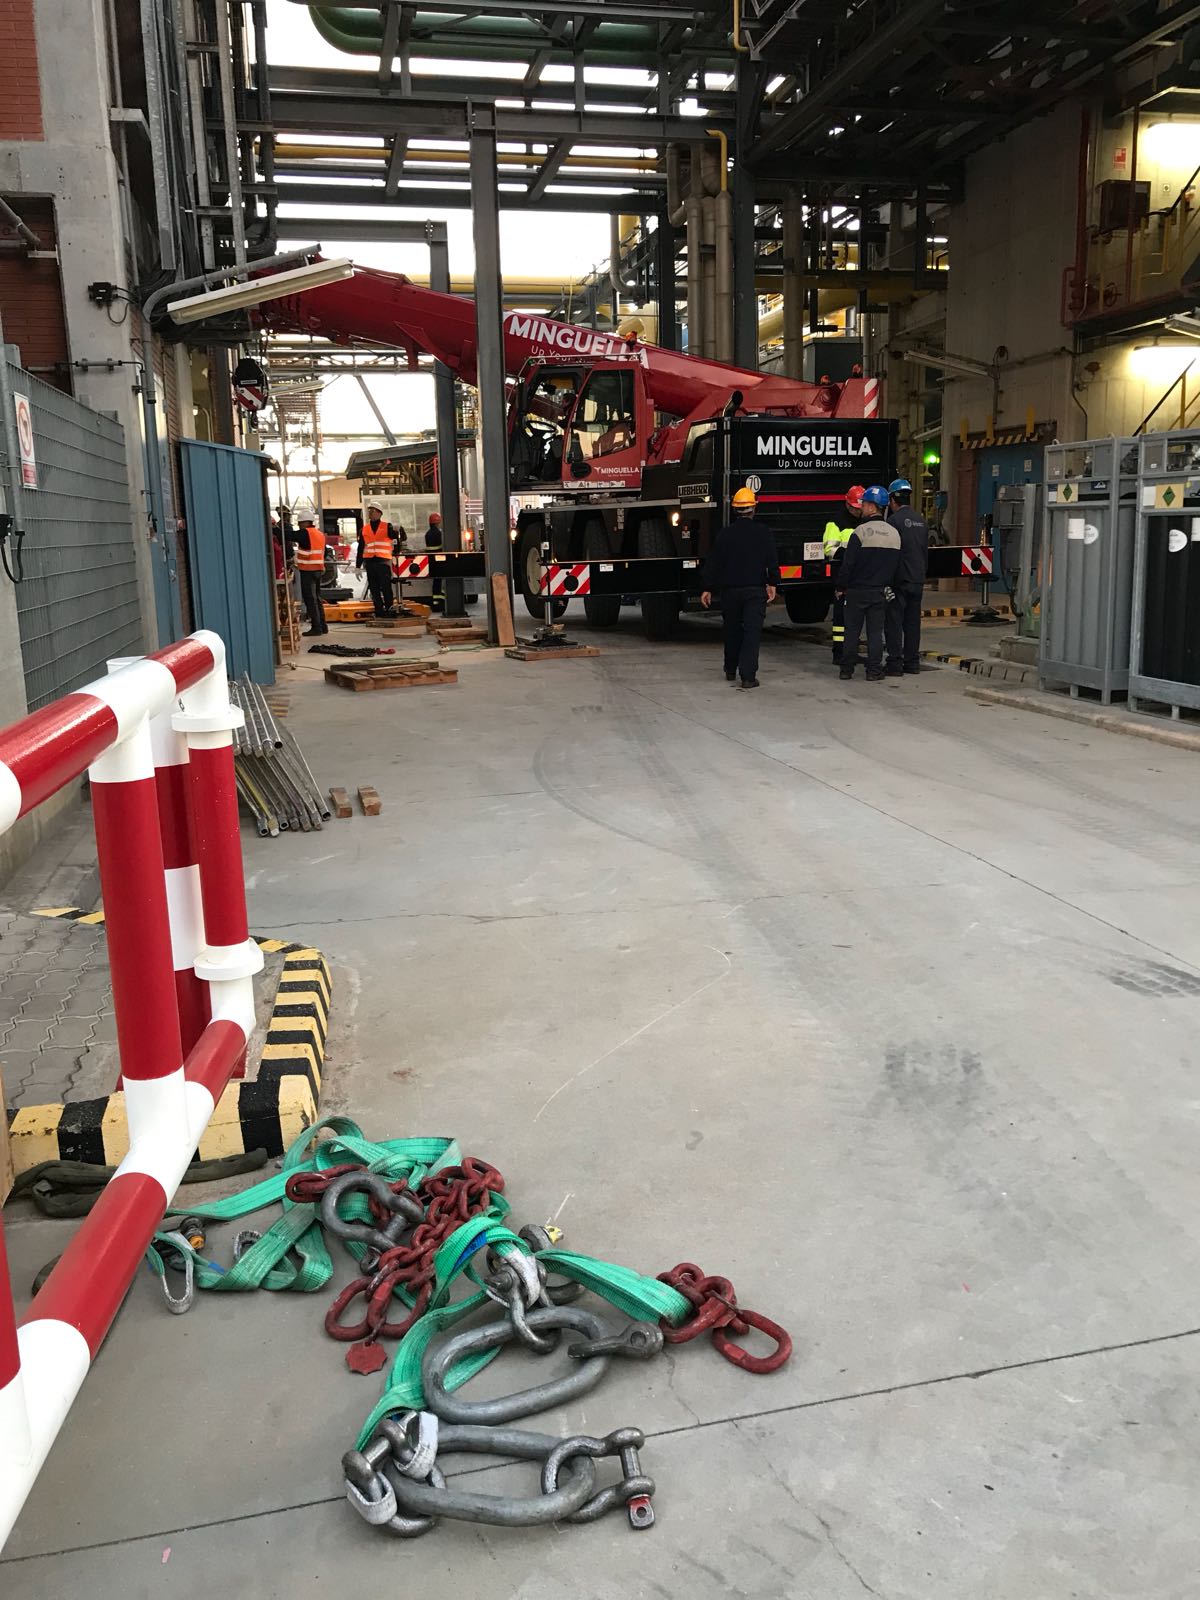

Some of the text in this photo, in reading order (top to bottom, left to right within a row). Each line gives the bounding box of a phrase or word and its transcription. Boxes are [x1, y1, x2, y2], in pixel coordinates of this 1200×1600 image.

[757, 435, 873, 456] MINGUELLA
[600, 466, 640, 474] MINGUELLA
[778, 459, 852, 469] Up Your Business
[748, 476, 760, 491] 70
[678, 484, 709, 497] LIEBHERR
